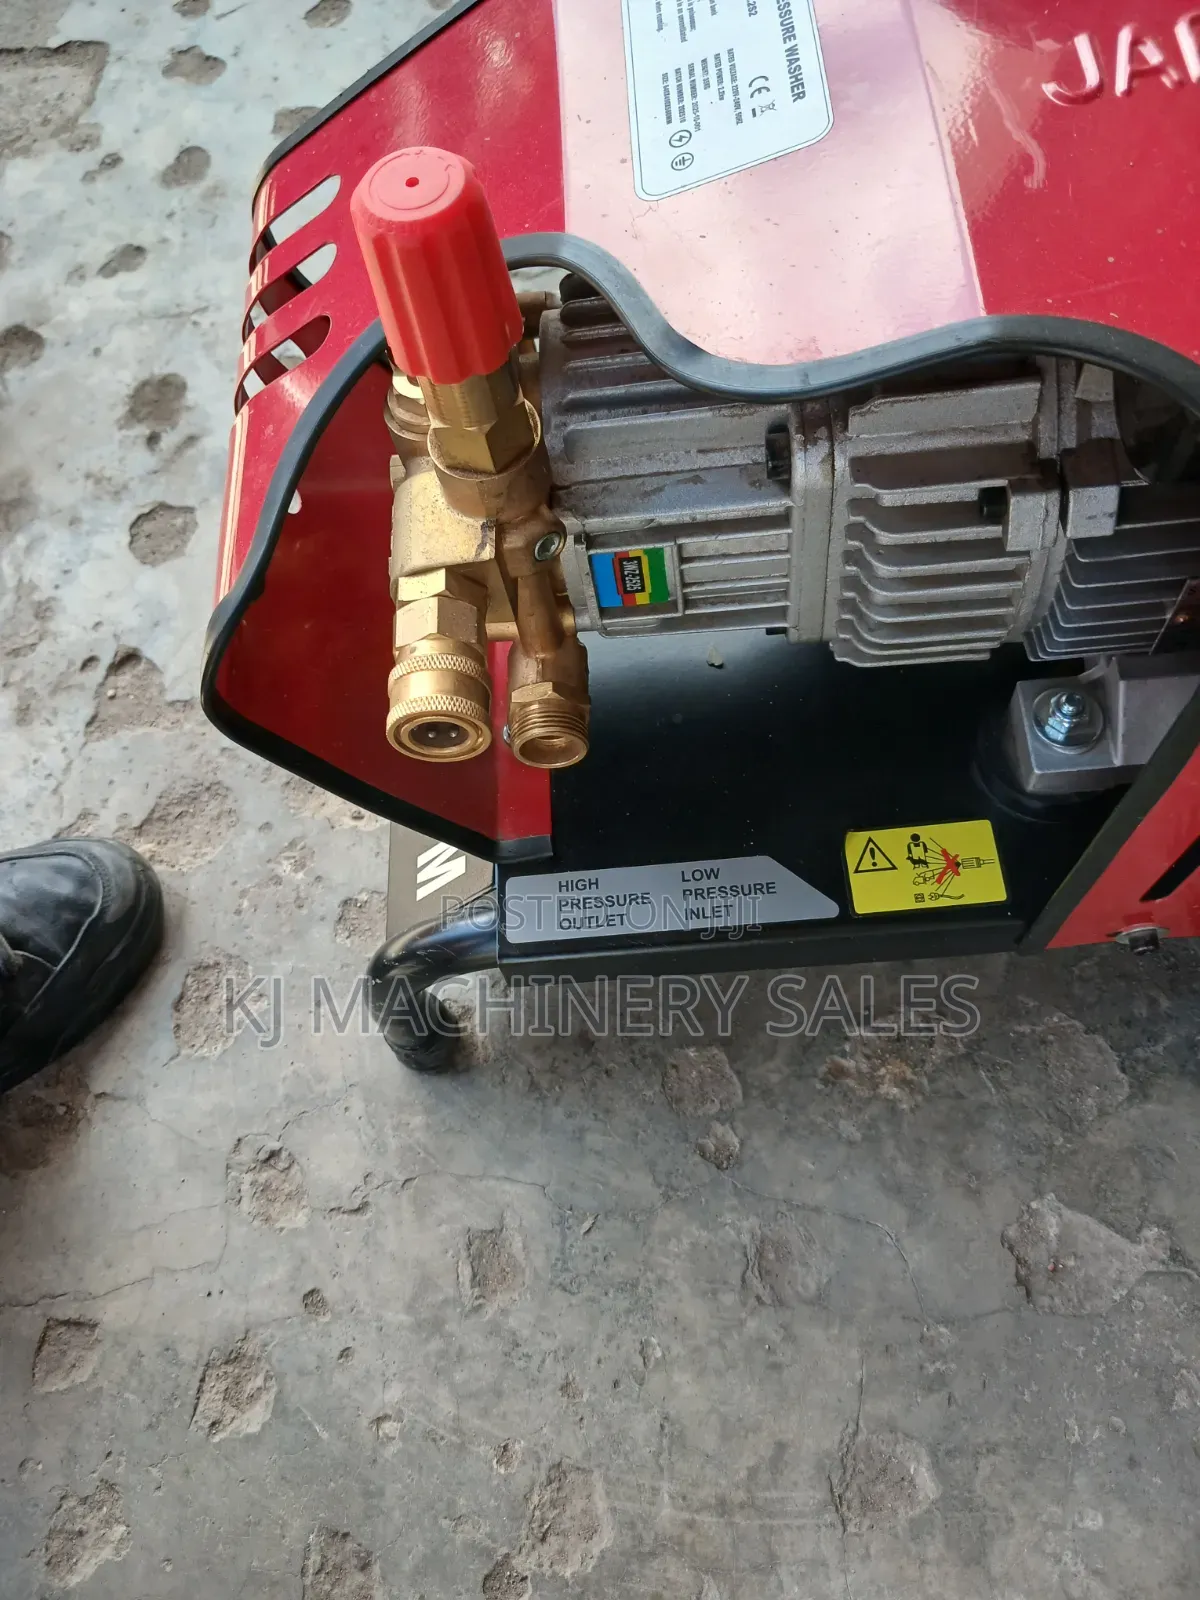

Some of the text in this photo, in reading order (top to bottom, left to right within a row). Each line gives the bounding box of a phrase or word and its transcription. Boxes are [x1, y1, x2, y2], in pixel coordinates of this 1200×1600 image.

[714, 52, 722, 68] RATED
[727, 48, 735, 63] RATED
[784, 43, 806, 103] WASHER
[681, 867, 720, 883] LOW
[558, 877, 600, 892] HIGH
[682, 881, 777, 900] PRESSURE
[559, 892, 652, 911] PRESSURE
[685, 904, 733, 921] INLET
[559, 913, 627, 931] OUTLET
